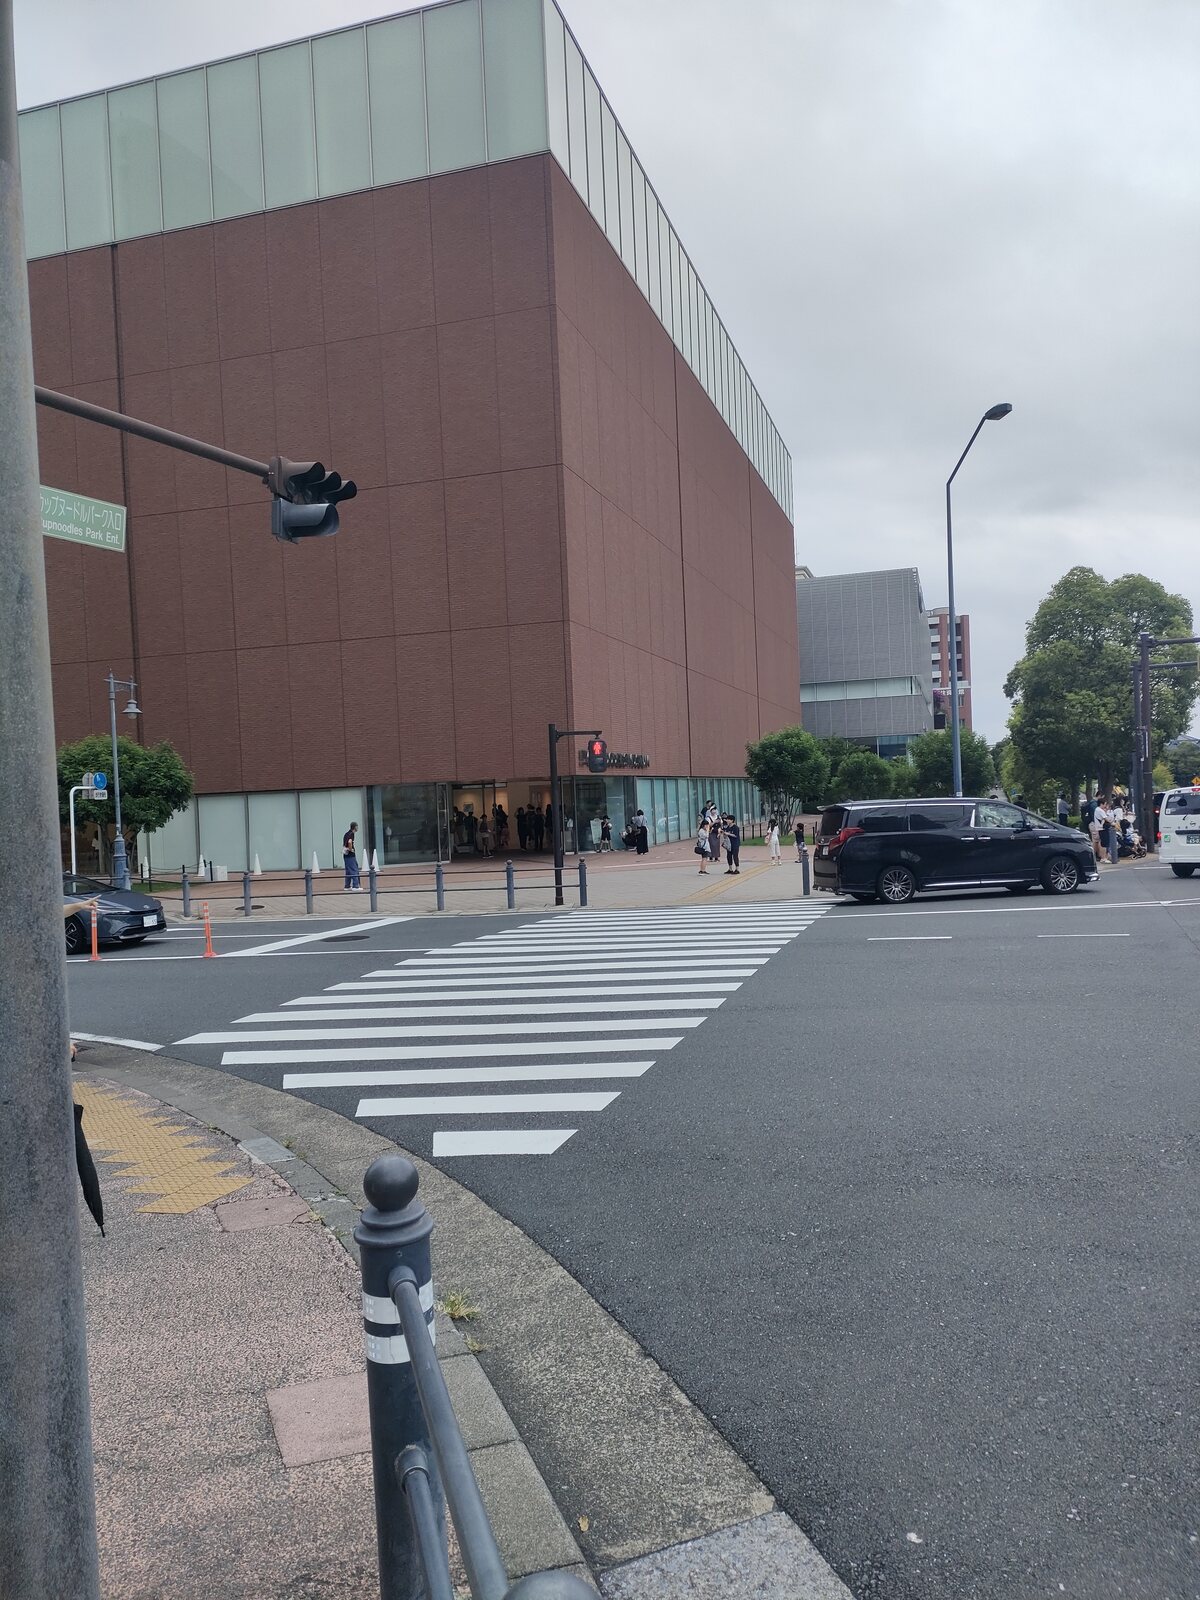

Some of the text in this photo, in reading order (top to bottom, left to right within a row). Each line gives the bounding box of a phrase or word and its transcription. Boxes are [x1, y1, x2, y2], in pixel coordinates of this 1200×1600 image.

[42, 519, 120, 545] upnoodles Park Ent.
